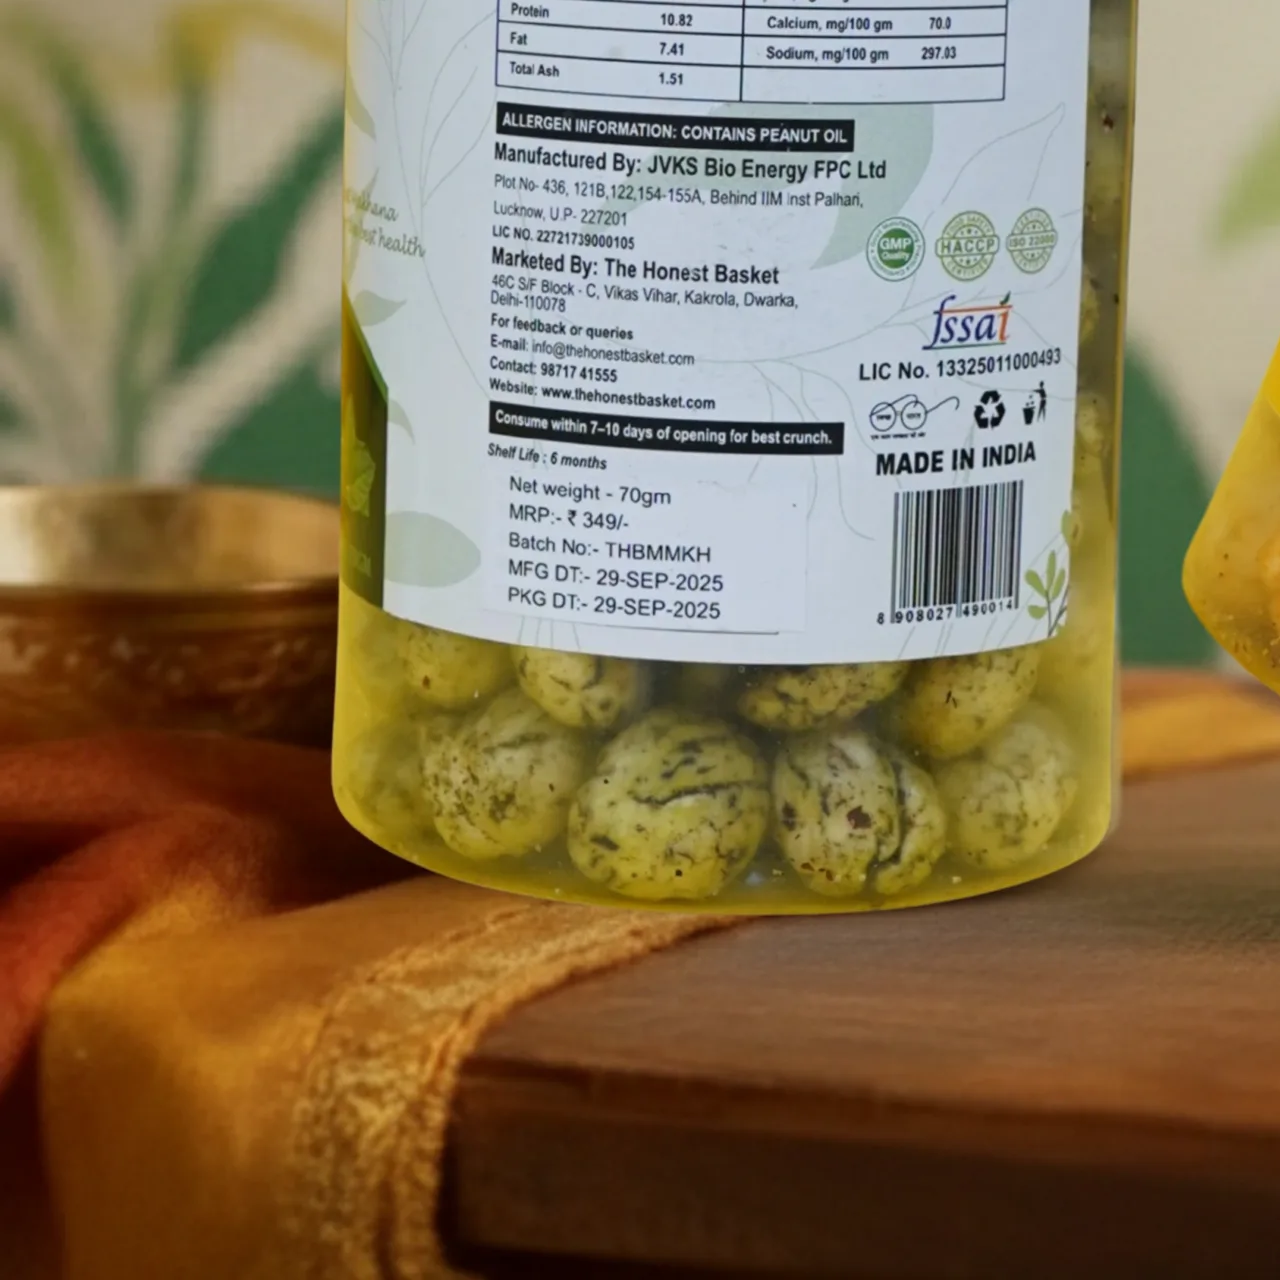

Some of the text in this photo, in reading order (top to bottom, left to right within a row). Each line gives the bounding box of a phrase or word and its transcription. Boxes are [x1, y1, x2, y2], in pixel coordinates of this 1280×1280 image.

[510, 2, 549, 18] Protein
[660, 13, 693, 27] 10.82
[767, 15, 893, 33] Calcium, mg/100 gm
[929, 16, 951, 30] 70.0
[510, 31, 527, 45] Fat
[659, 42, 684, 56] 7.41
[766, 45, 889, 64] Sodium, mg/100 gm
[921, 46, 956, 60] 297.03
[510, 60, 560, 77] Total Ash
[658, 72, 683, 85] 1.51
[501, 111, 847, 143] ALLERGEN INFORMATION: CONTAINS PEANUT OIL
[494, 141, 886, 184] Manufactured By: JVKS Bio Energy FPC Ltd
[879, 238, 911, 251] GMP
[940, 238, 995, 255] HACCP
[491, 245, 779, 284] Marketed By: The Honest Basket
[922, 291, 1013, 351] fssai
[859, 347, 1061, 381] LIC No. 13325011000493
[875, 441, 1036, 476] MADE IN INDIA
[509, 475, 538, 494] Net
[542, 482, 600, 503] weight
[619, 486, 671, 508] 70gm
[567, 509, 577, 526] ₹
[509, 531, 555, 552] Batch
[605, 541, 711, 563] THBMMKH
[508, 558, 549, 580] MFG
[596, 568, 723, 592] 29-SEP-2025
[508, 586, 546, 607] PKG
[593, 595, 721, 619] 29-SEP-2025
